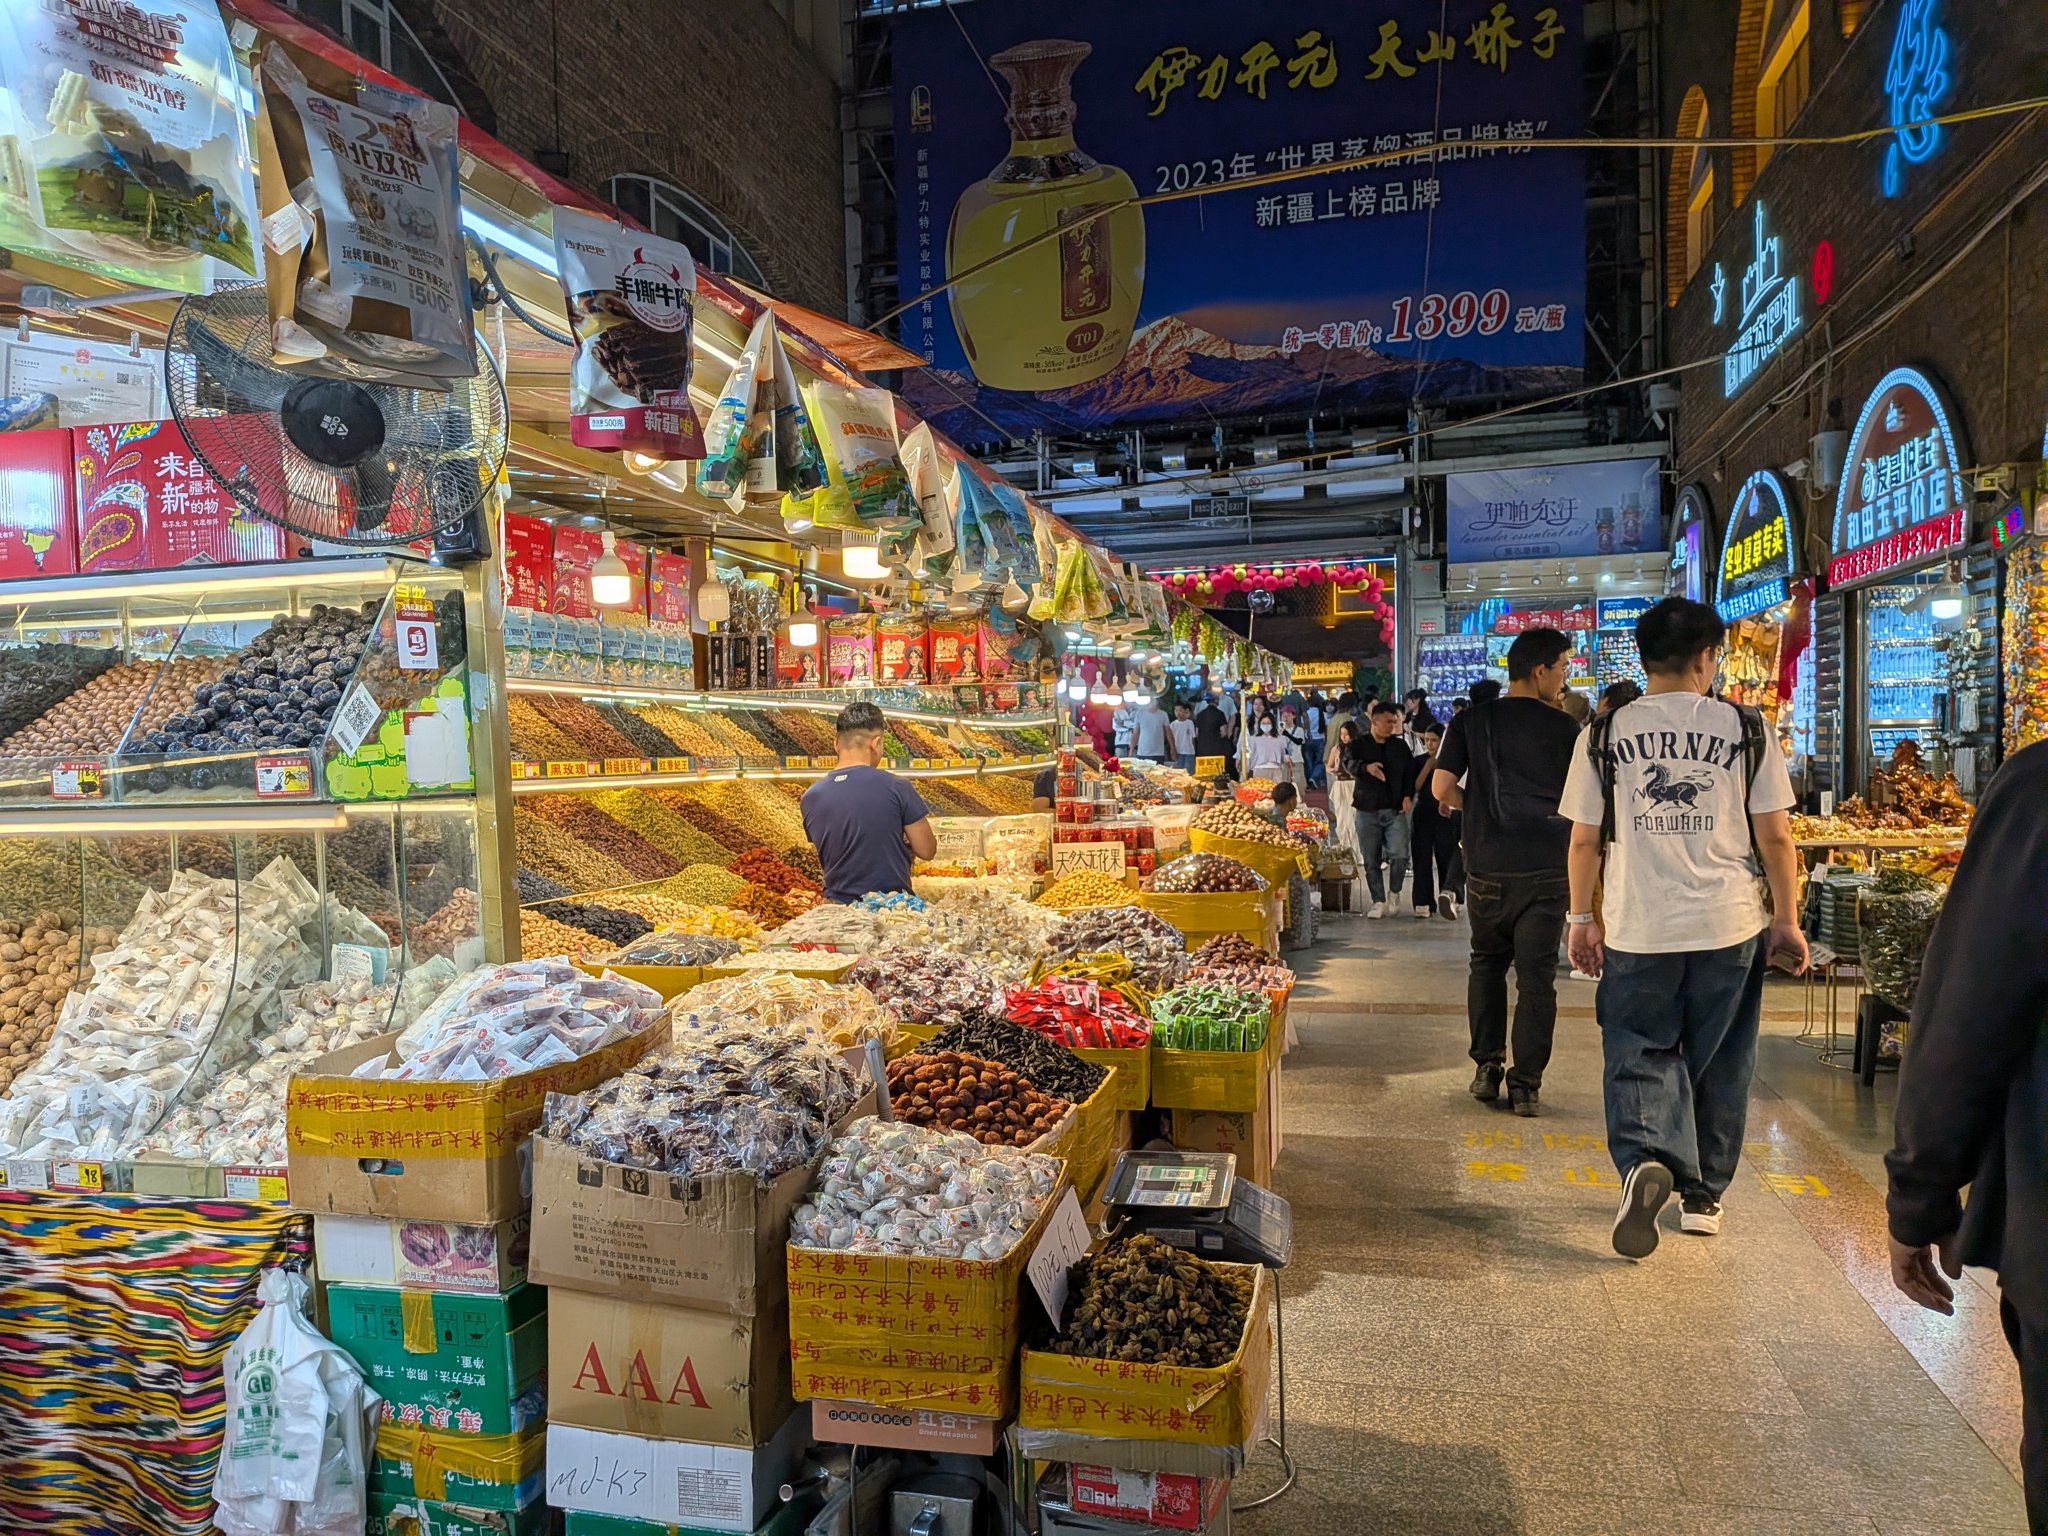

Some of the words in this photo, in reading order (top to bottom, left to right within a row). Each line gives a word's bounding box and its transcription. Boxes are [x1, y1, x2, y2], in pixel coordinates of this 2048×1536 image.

[1134, 30, 1338, 116] 伊力开元
[1365, 3, 1567, 80] 天山娇子
[1256, 178, 1441, 228] 新疆上榜品牌
[1074, 329, 1099, 347] T01
[1387, 289, 1511, 343] 1399
[1515, 304, 1567, 333] 元/瓶
[1847, 469, 1947, 550] 和田玉平价店
[1725, 515, 1784, 580] 冬虫夏草专卖
[550, 763, 587, 776] 黑玫瑰
[1612, 731, 1742, 771] OURNEY
[1633, 815, 1714, 831] FORWARD
[247, 1375, 272, 1394] GB
[572, 1341, 713, 1410] AAA
[919, 1428, 938, 1437] Dried
[951, 1431, 977, 1440] apricot
